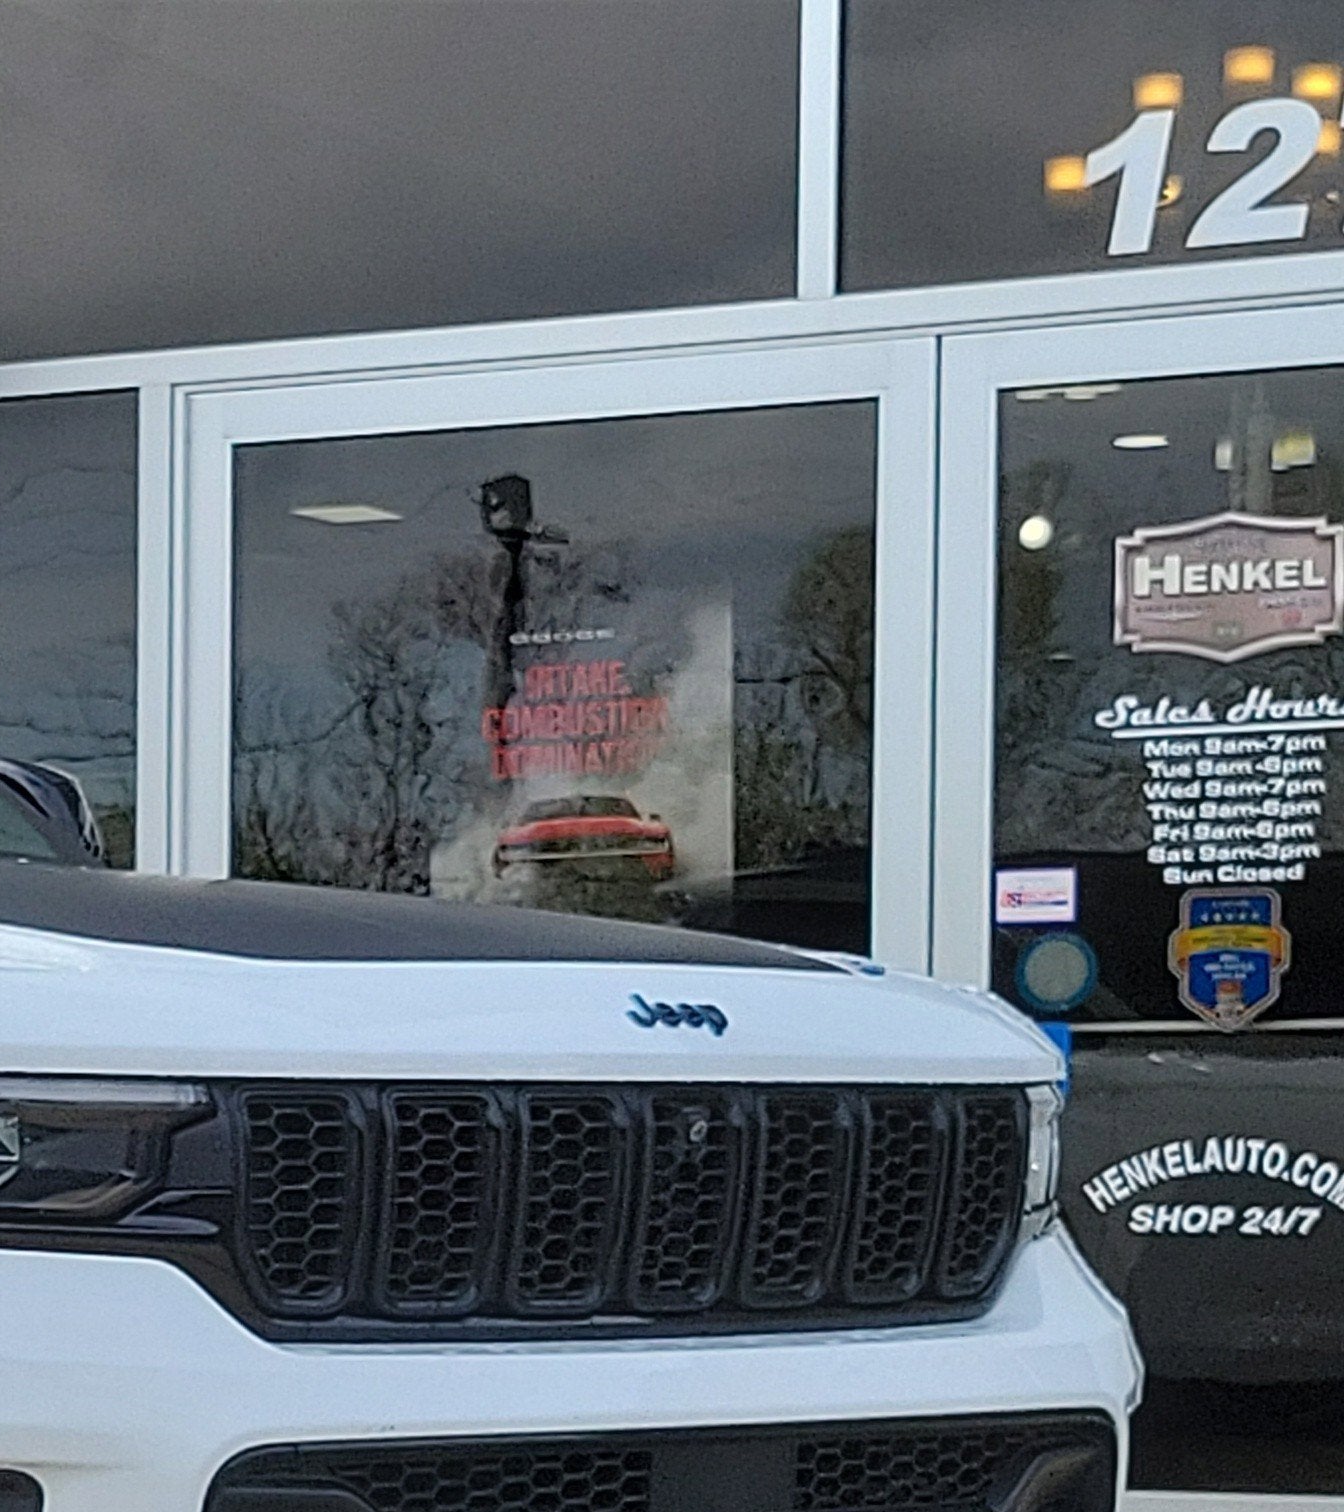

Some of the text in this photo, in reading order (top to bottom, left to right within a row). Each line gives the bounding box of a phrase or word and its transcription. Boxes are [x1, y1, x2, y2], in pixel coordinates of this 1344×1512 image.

[1082, 97, 1344, 256] 12
[1132, 554, 1328, 598] HENKEL
[1094, 695, 1215, 728] Sales
[1143, 739, 1201, 758] Mon
[1145, 760, 1192, 779] Tue
[1142, 780, 1202, 800] Wed
[1146, 803, 1196, 821] Thu
[1152, 824, 1190, 842] Fri
[1146, 845, 1195, 864] Sat
[1162, 862, 1306, 885] Sun Closed
[625, 992, 730, 1037] Jeep
[1127, 1203, 1323, 1236] SHOP 24/7
